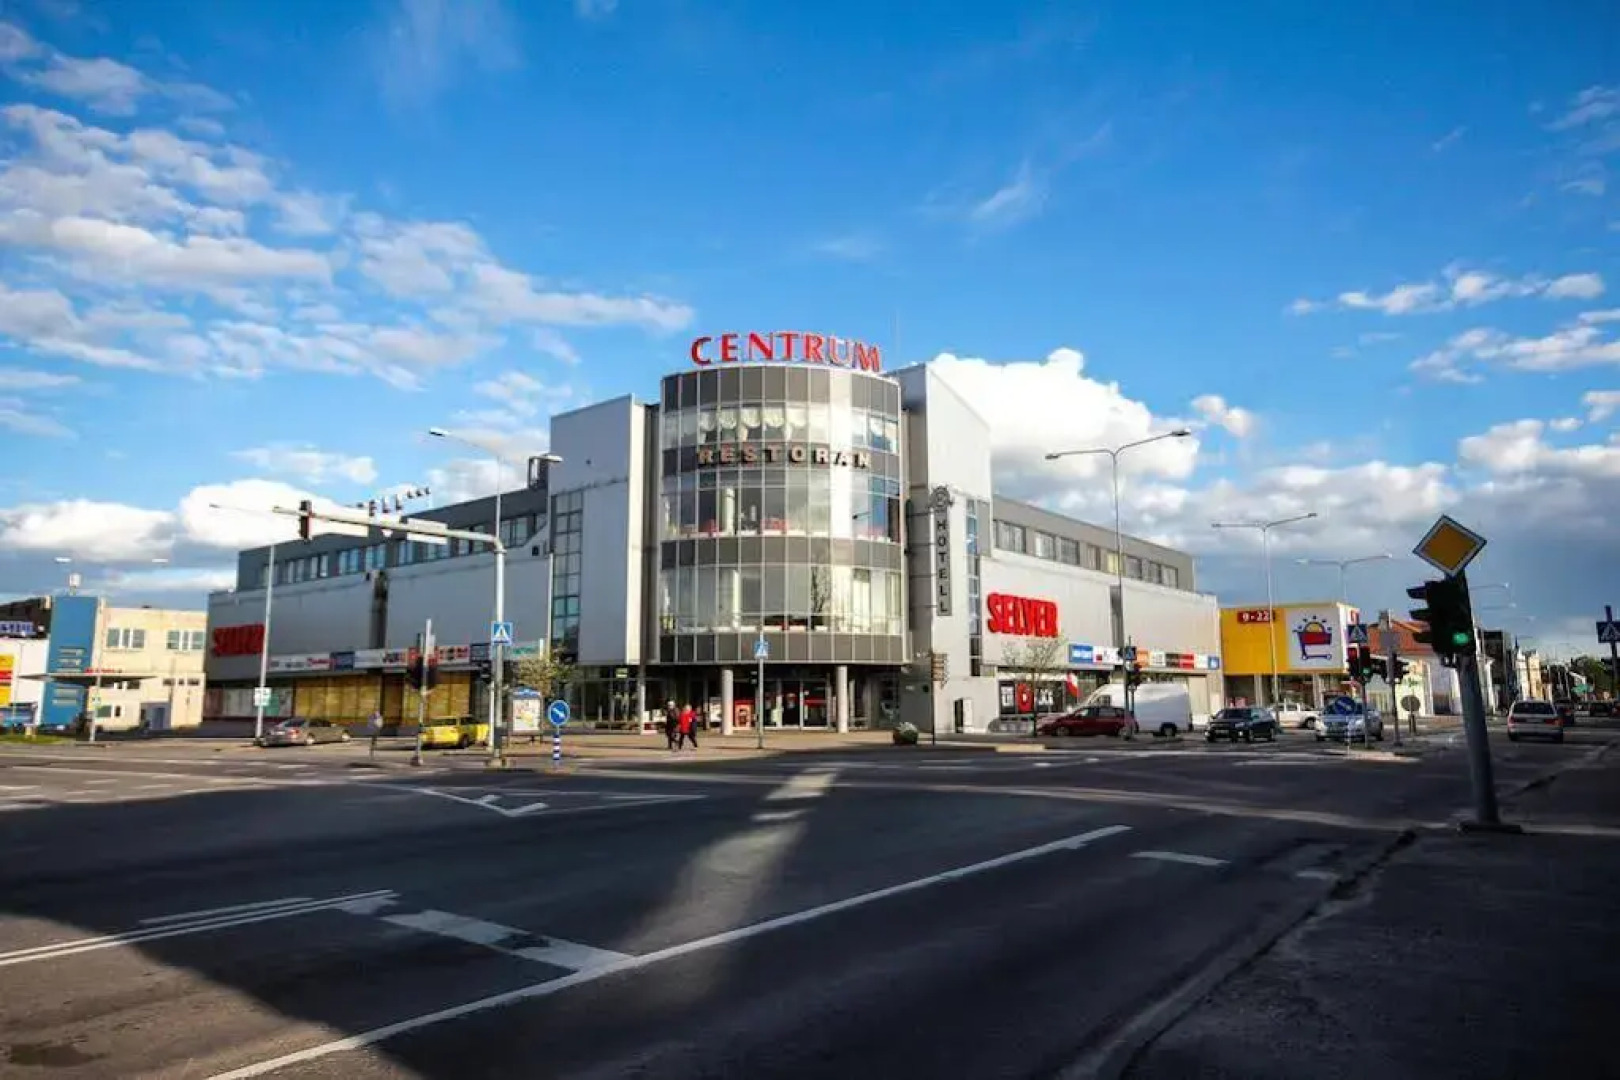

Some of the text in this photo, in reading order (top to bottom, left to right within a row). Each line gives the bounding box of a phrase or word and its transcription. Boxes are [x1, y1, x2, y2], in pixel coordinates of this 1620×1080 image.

[690, 331, 881, 373] CENTRUM
[697, 443, 872, 469] RESTORAN
[936, 519, 948, 613] HOTELL
[987, 592, 1057, 638] SELVER
